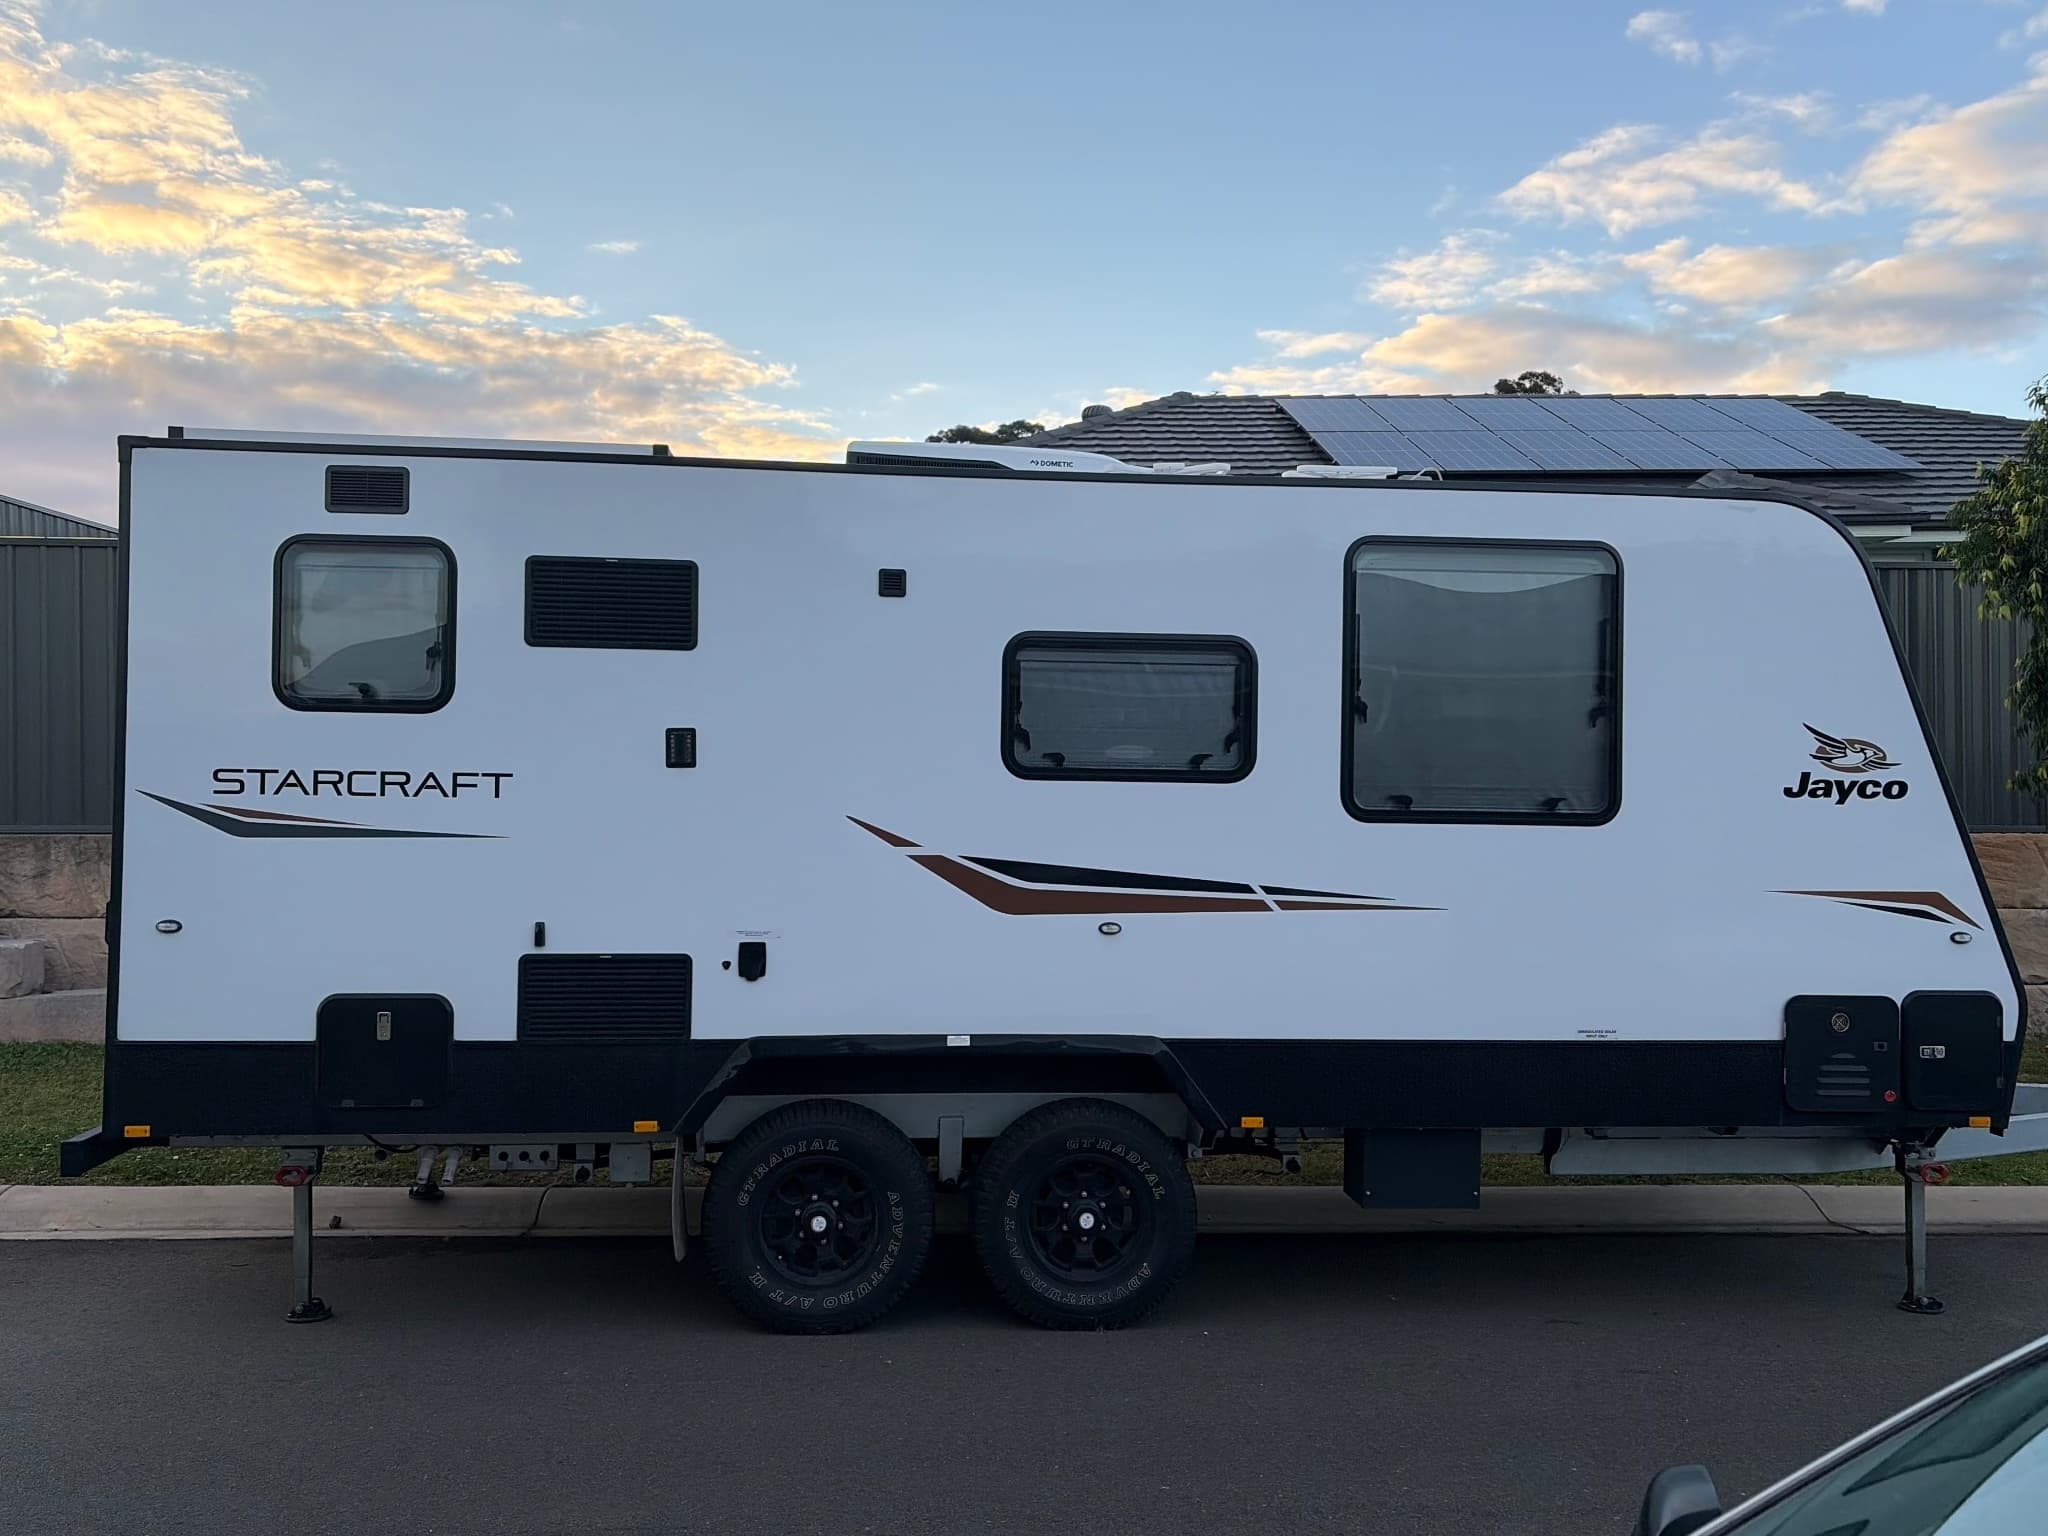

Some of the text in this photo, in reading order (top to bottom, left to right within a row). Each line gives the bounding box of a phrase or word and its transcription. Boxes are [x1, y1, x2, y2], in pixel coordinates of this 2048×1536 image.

[1040, 460, 1074, 468] DOMETIC
[212, 768, 514, 799] STARCRAFT
[1783, 771, 1909, 805] Jayco
[823, 1191, 904, 1309] ADVENTURO
[769, 1289, 815, 1309] A/T
[1020, 1262, 1152, 1306] ADVENTURO
